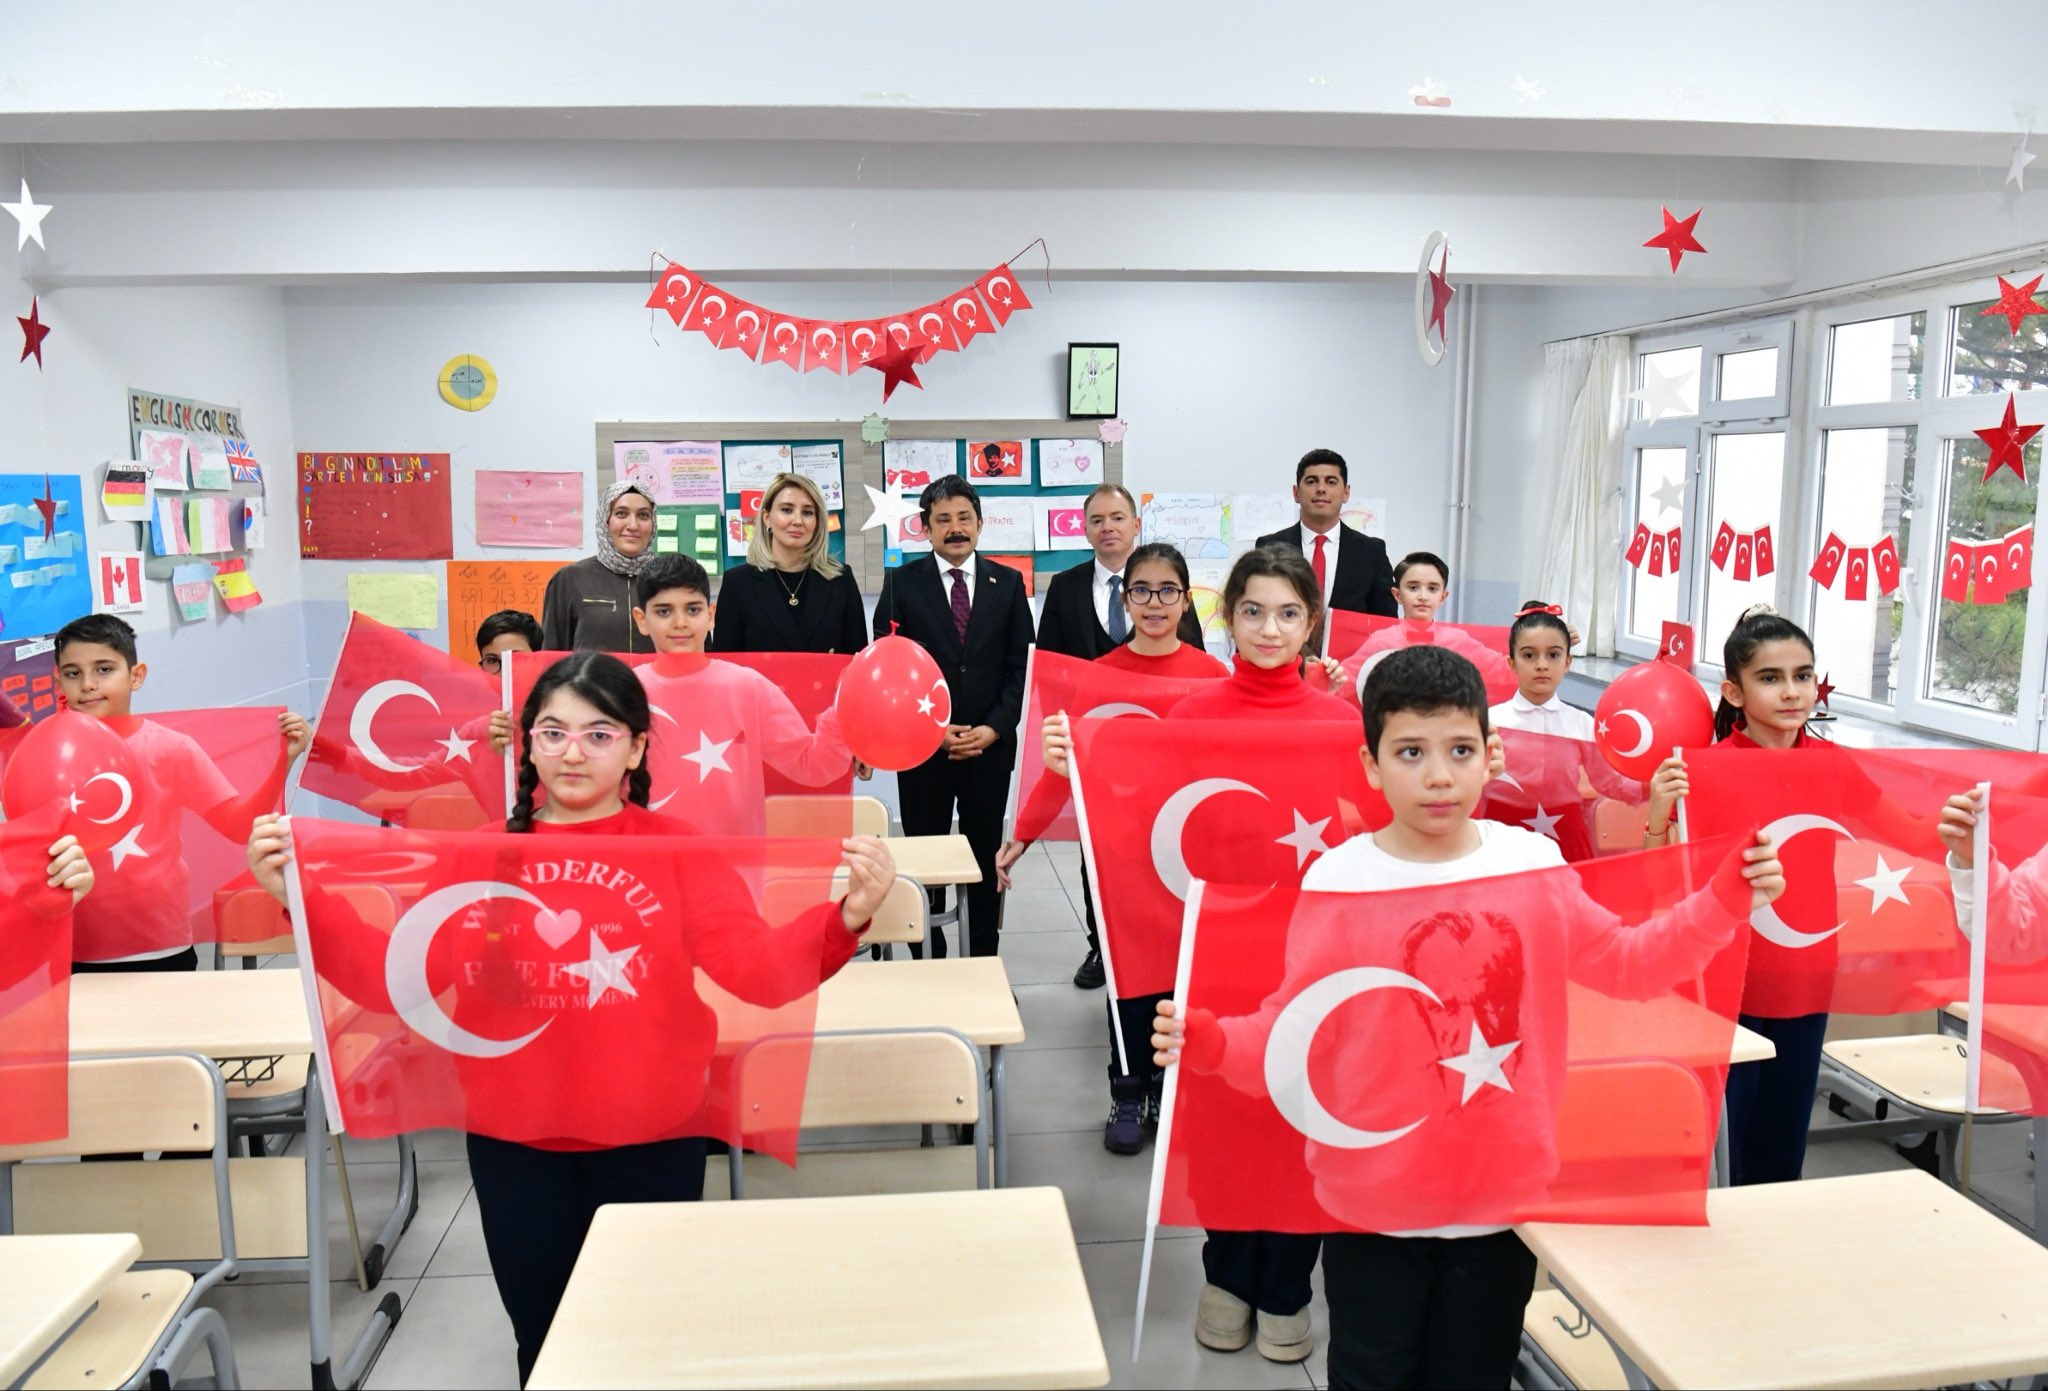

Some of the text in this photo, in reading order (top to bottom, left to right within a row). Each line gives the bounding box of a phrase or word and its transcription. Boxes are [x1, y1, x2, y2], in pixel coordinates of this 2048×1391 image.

[132, 395, 245, 439] ENGLISH CORNER
[594, 922, 623, 934] 1996
[546, 954, 654, 989] FUNNY
